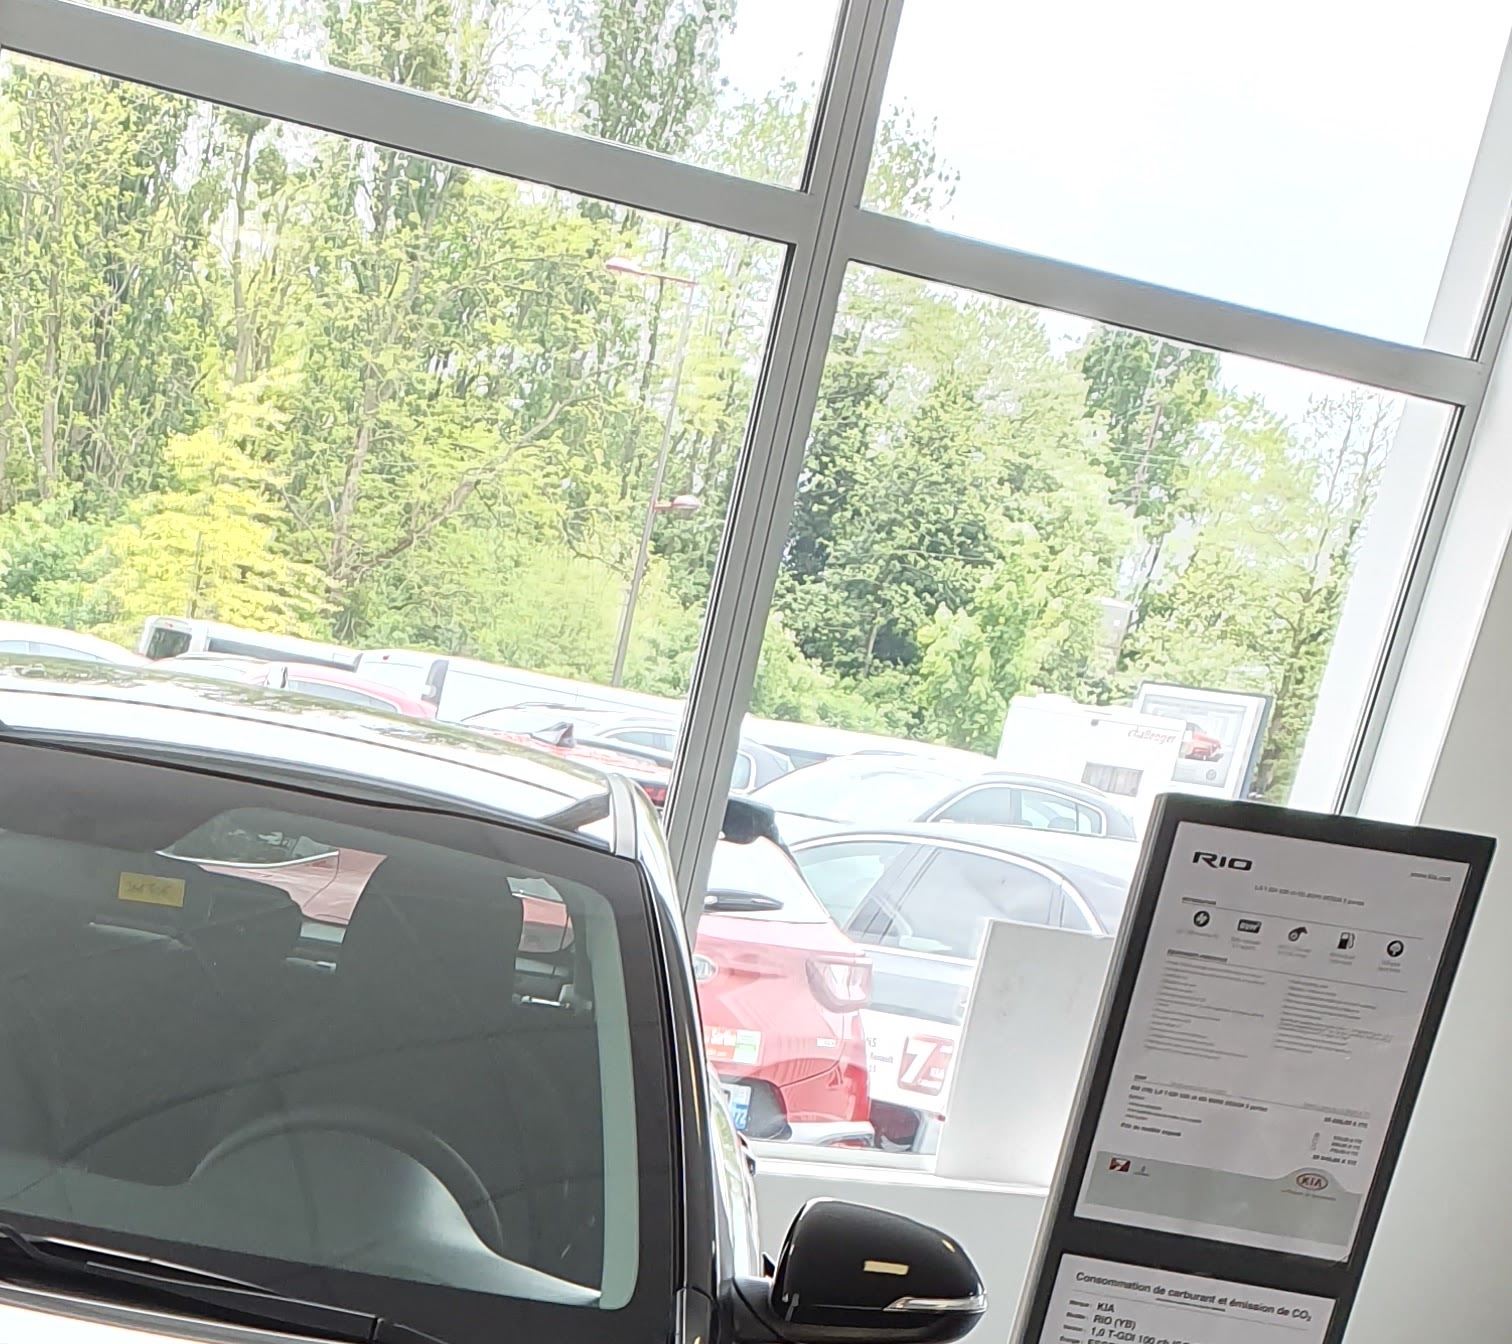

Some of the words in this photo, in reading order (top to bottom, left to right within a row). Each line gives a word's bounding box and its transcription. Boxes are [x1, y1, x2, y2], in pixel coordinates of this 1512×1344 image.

[1192, 851, 1253, 871] RIO
[1301, 1175, 1323, 1188] KIA
[1076, 1271, 1151, 1294] Consommation
[1153, 1285, 1166, 1296] de
[1168, 1287, 1216, 1306] carburant
[1219, 1297, 1228, 1306] et
[1229, 1297, 1274, 1316] émission
[1276, 1305, 1290, 1317] de
[1096, 1302, 1115, 1313] KIA
[1093, 1314, 1113, 1325] RIO
